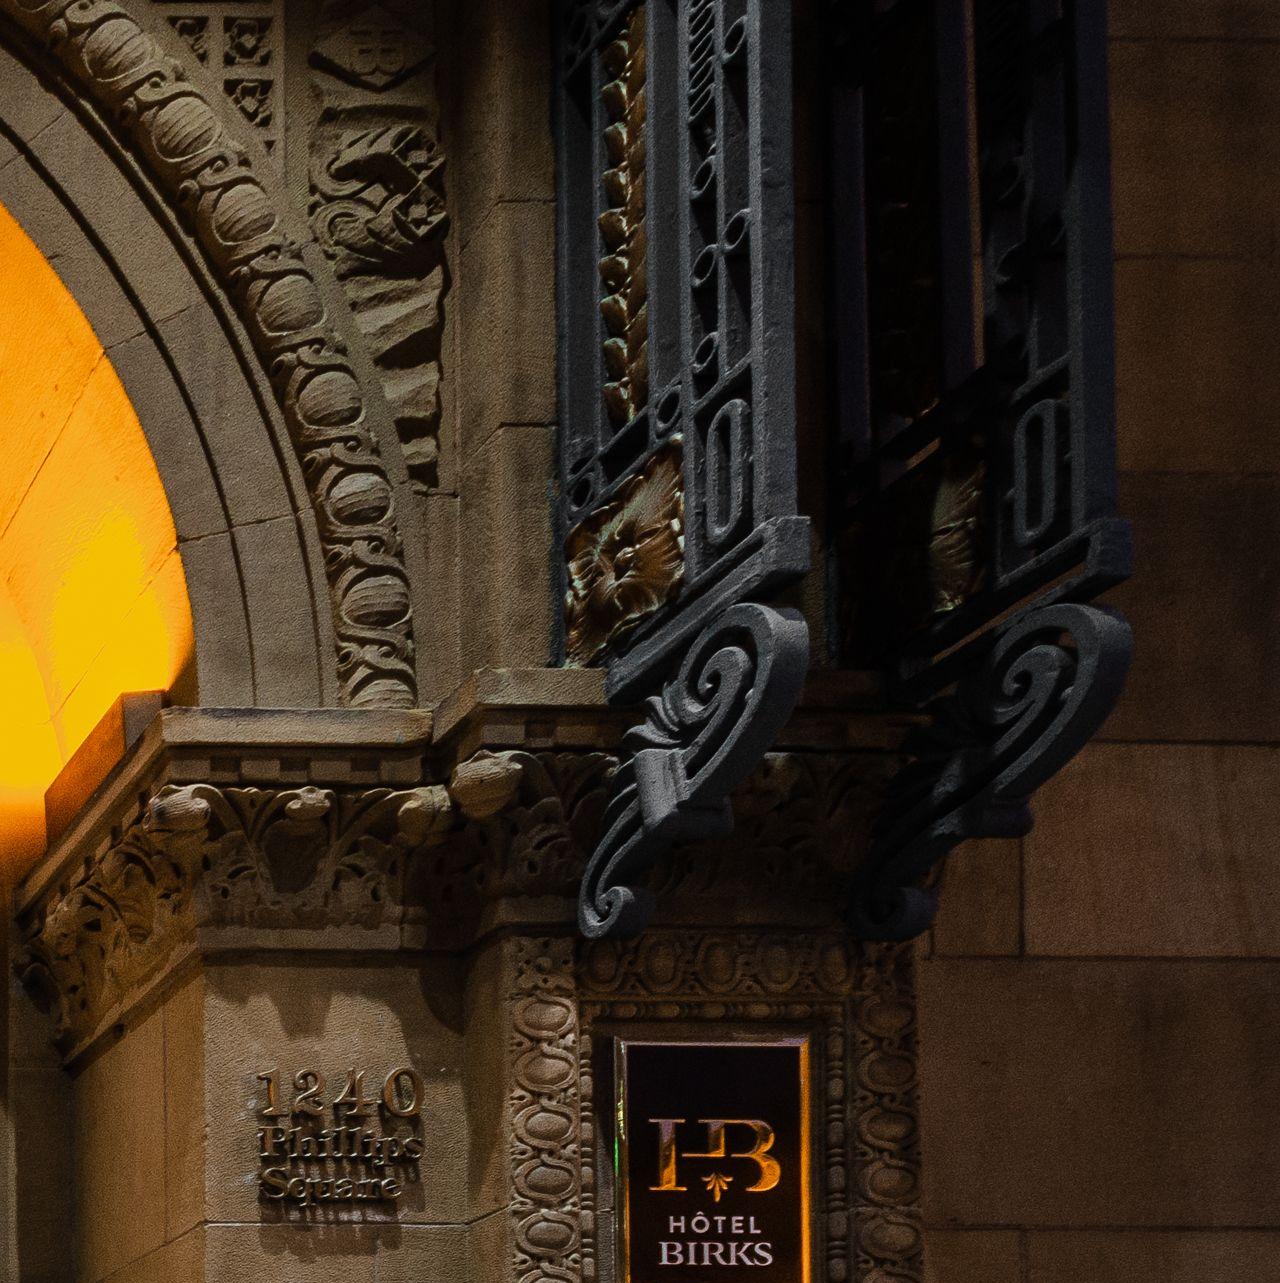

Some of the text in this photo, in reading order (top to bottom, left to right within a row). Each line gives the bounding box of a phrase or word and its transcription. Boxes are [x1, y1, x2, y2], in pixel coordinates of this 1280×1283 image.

[257, 1067, 425, 1117] 1240
[257, 1126, 426, 1166] Phillips
[260, 1167, 402, 1207] Square
[668, 1211, 762, 1235] HÔTEL
[658, 1241, 775, 1267] BIRKS
